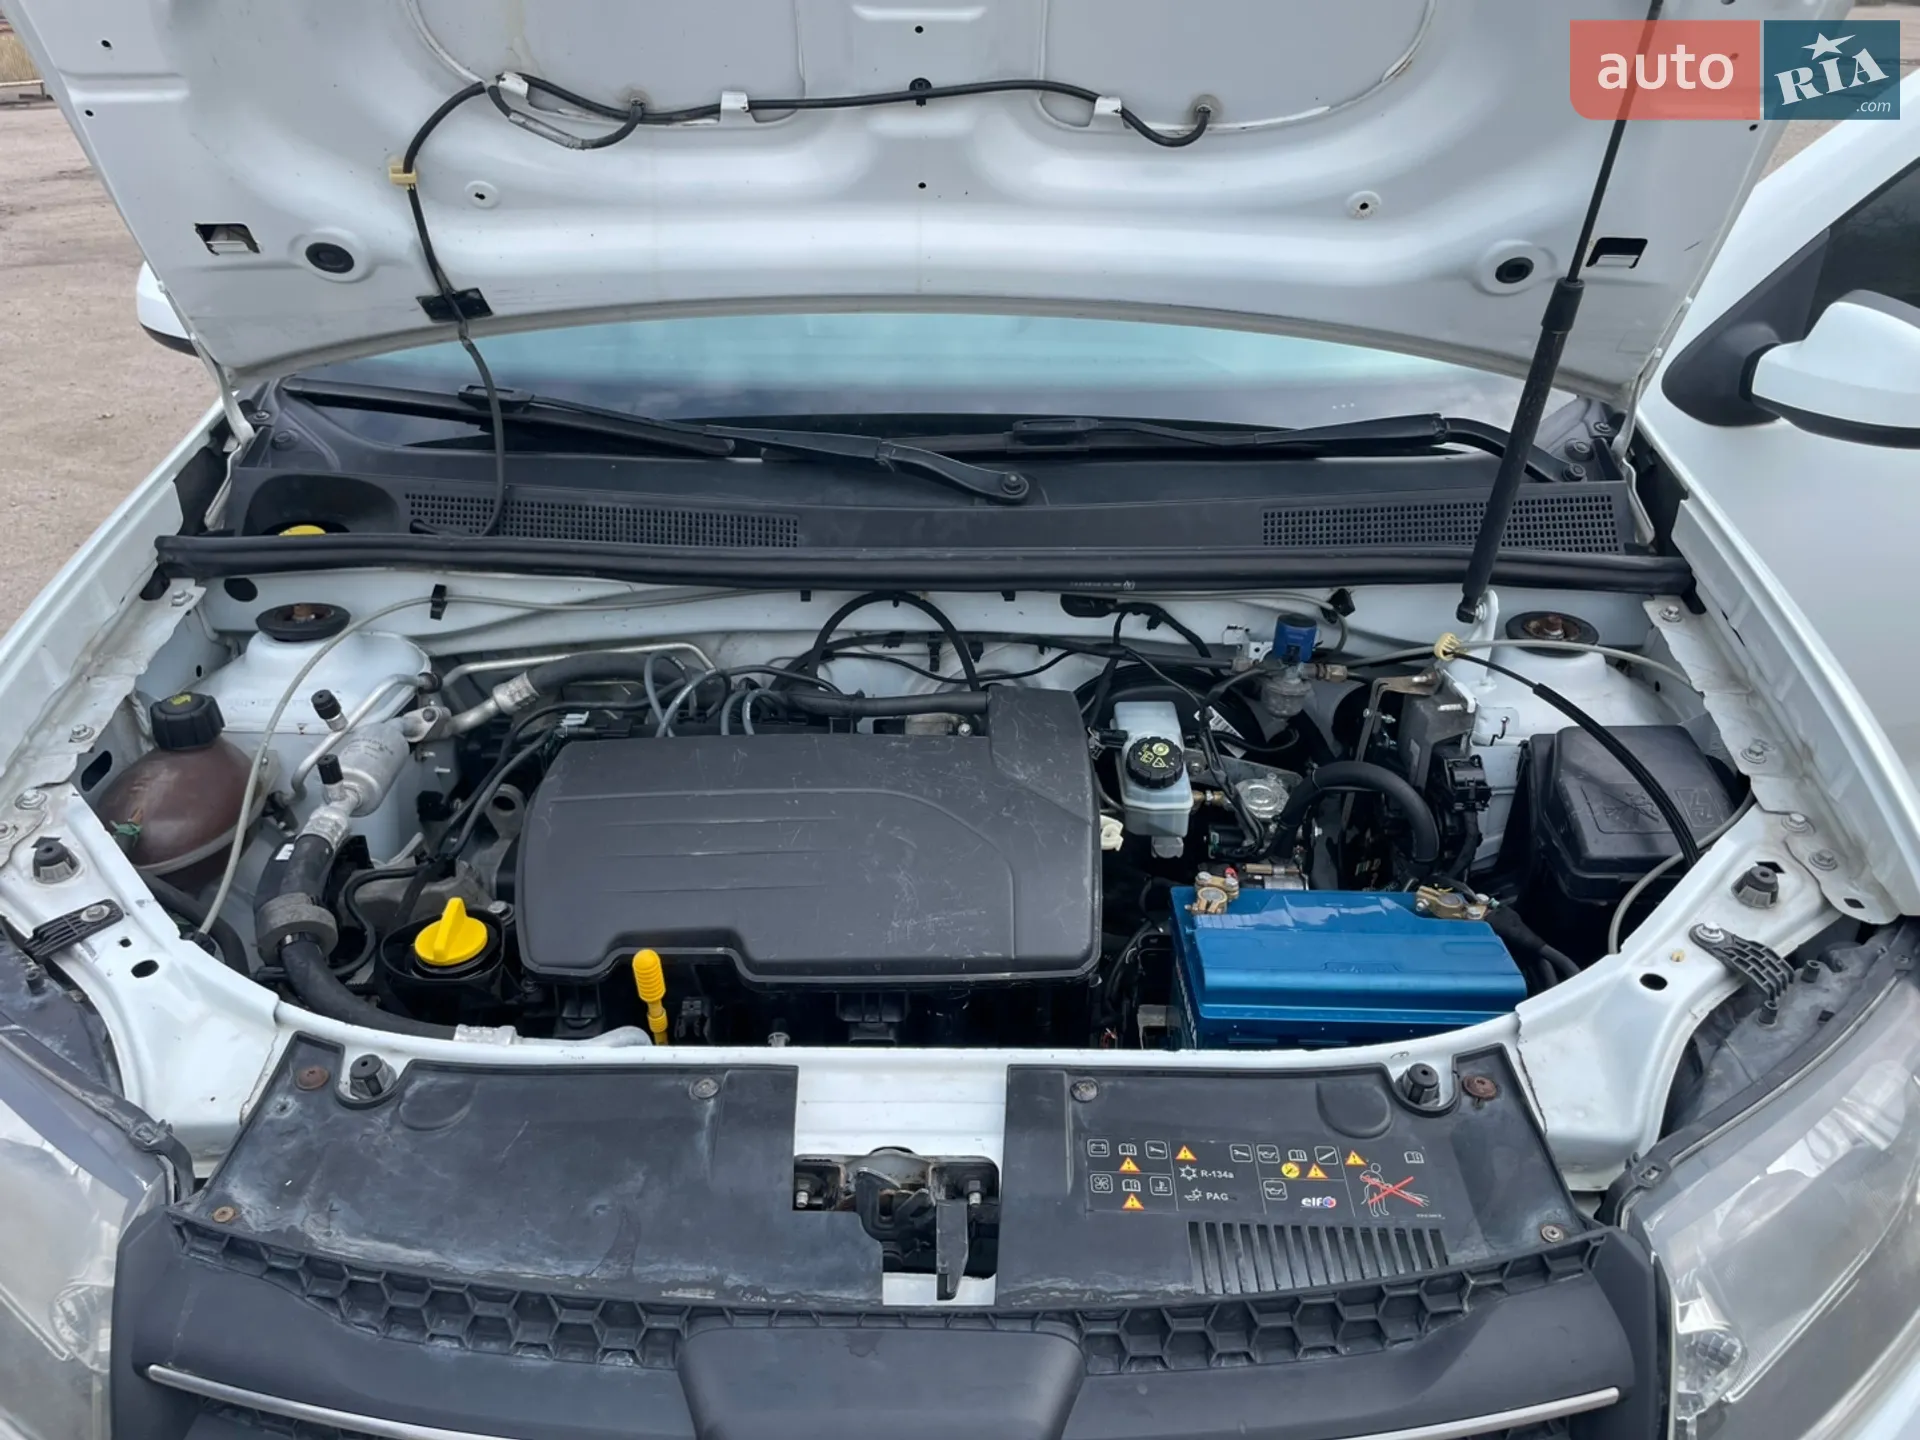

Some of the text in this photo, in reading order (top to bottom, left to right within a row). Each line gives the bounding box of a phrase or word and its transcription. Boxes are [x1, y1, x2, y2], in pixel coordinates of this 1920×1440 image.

[1200, 1169, 1235, 1179] R-134a
[1206, 1191, 1229, 1201] PAG
[1301, 1197, 1322, 1207] elf
